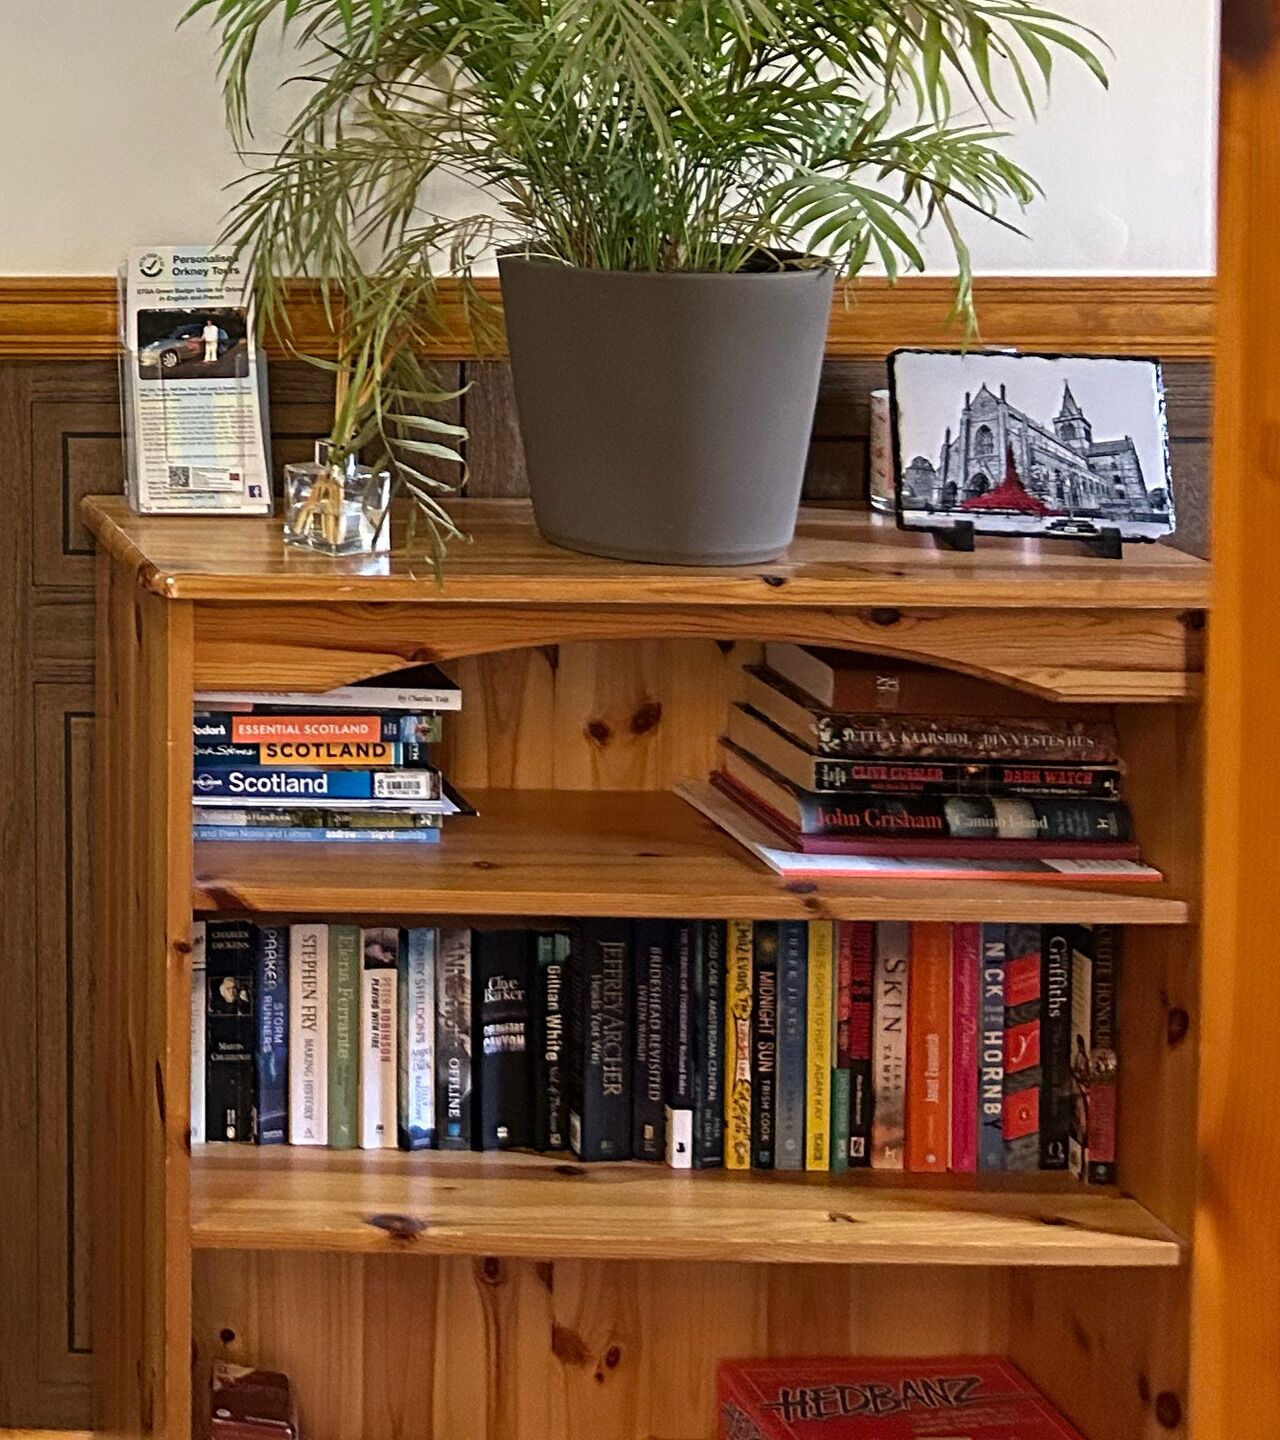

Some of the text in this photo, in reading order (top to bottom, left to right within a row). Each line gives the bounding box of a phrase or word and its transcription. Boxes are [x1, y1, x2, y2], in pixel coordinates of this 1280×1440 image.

[172, 254, 238, 265] Personalise
[172, 267, 209, 277] Orkney
[238, 723, 302, 735] ESSENTIAL
[303, 723, 370, 735] SCOTLAND
[266, 742, 387, 758] SCOTLAND
[228, 771, 329, 793] Scotland
[1003, 769, 1094, 785] DARK WATCH
[815, 805, 943, 830] John Grisham
[263, 929, 278, 992] PARKER
[300, 933, 318, 1033] STEPHEN FRY
[337, 934, 355, 983] Elena
[488, 975, 519, 991] Clive
[708, 960, 718, 987] CASE
[1048, 935, 1068, 1018] Griffiths
[263, 995, 274, 1054] RUNNERS
[273, 1002, 284, 1044] STORM
[336, 987, 354, 1060] Ferrante
[370, 977, 381, 1049] PLAYING WITH FIRE
[380, 976, 392, 1063] PETER ROBINSON
[483, 988, 526, 1003] Barker
[545, 964, 562, 1061] Gillian White
[589, 974, 603, 1065] Heads You Win
[600, 940, 626, 1096] JEFFREY ARCHER
[637, 984, 647, 1021] EVELYN
[647, 946, 662, 1102] BRIDESHEAD REVISITED
[757, 970, 775, 1072] MIDNIGHT SUN
[883, 958, 906, 1034] SKIN
[707, 999, 718, 1058] AMSTERDAM
[983, 941, 1004, 1130] NICK HORNBY
[303, 1038, 315, 1121] MAKING HISTORY
[447, 1057, 460, 1118] OFFLINE
[707, 1059, 717, 1102] CENTRAL
[760, 1079, 770, 1142] TRISH COOK
